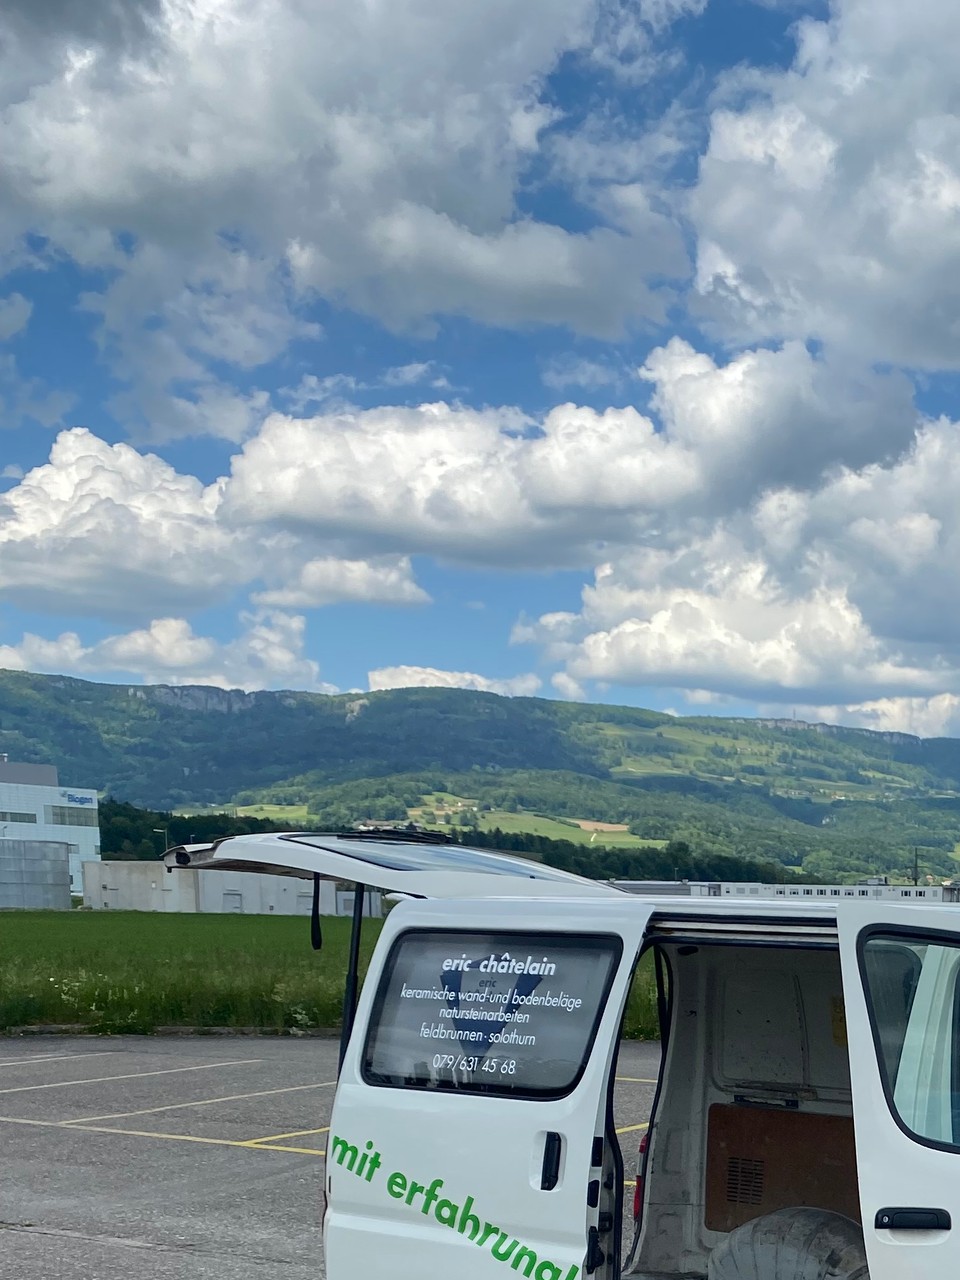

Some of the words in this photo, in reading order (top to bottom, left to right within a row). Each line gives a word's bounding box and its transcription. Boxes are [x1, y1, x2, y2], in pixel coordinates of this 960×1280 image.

[442, 953, 472, 972] eric
[479, 952, 556, 975] châtelain
[479, 976, 497, 988] eric
[400, 983, 456, 1001] keramische
[511, 988, 582, 1012] bodenbeläge
[439, 1006, 530, 1024] natursteinarbeiten
[432, 1054, 478, 1072] 079/631
[482, 1058, 497, 1072] 45
[500, 1060, 516, 1075] 68
[331, 1135, 381, 1182] mit
